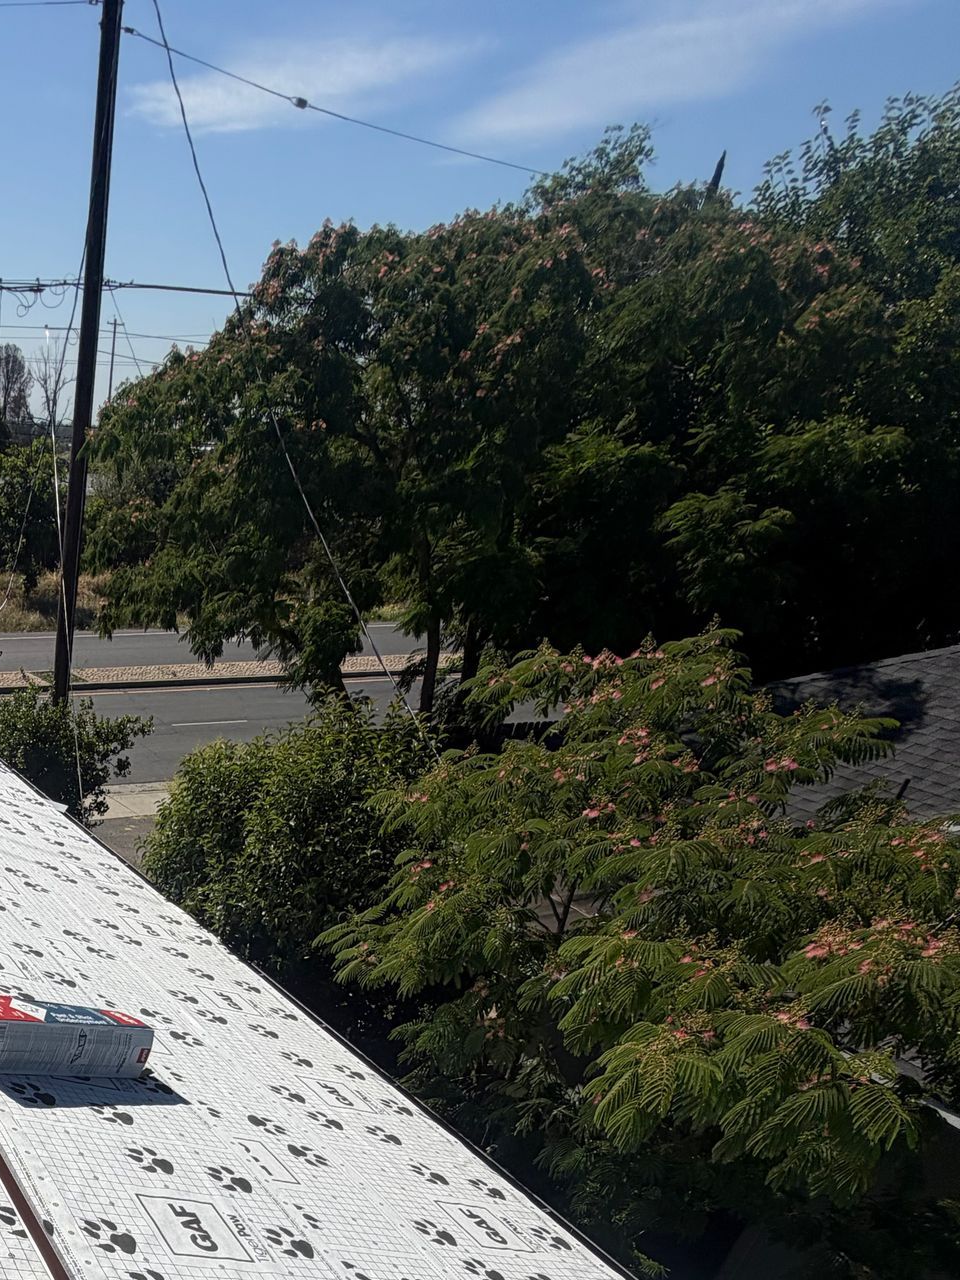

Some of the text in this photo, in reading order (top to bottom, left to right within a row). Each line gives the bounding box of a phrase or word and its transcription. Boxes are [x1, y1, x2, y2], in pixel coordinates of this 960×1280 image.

[315, 1081, 354, 1107] GAF
[168, 1203, 218, 1252] GAF
[458, 1207, 508, 1245] GAF
